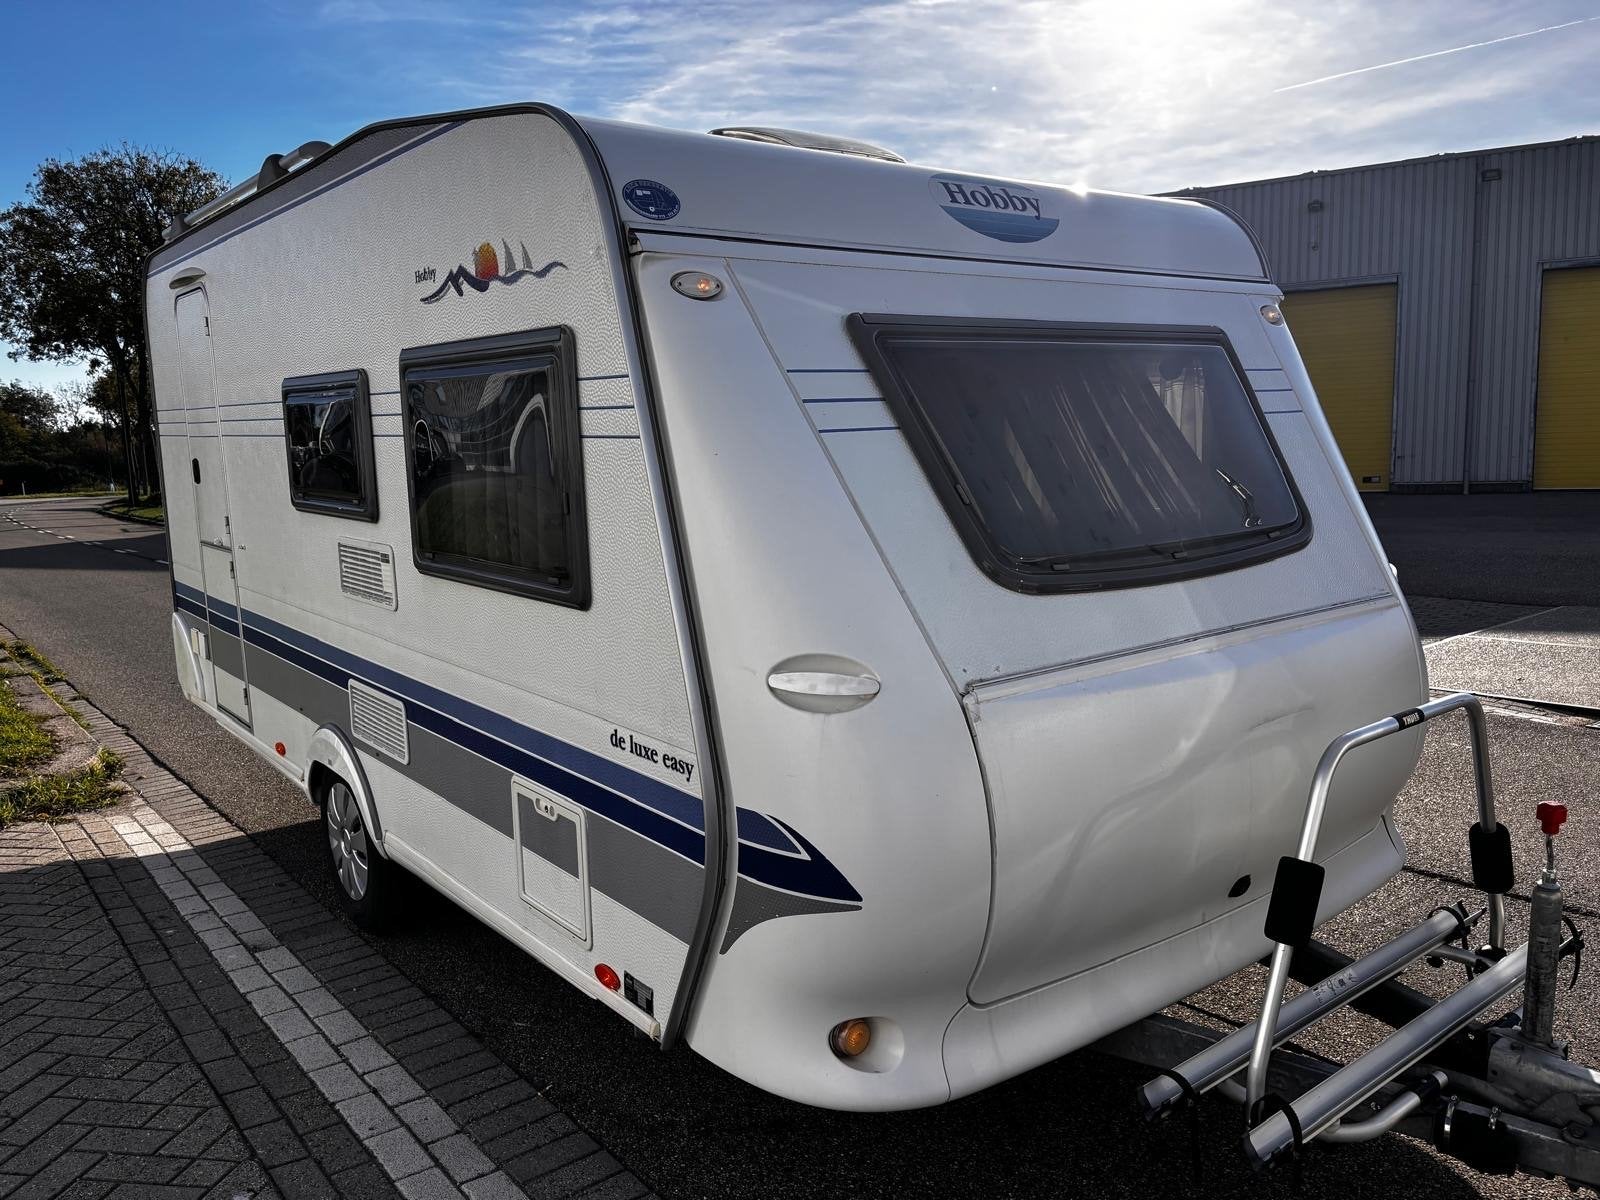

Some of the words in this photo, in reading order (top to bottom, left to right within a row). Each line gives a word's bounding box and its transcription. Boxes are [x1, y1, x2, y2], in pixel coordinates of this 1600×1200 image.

[938, 181, 1041, 220] Hobby
[415, 266, 436, 283] Hobby
[610, 728, 626, 751] de
[629, 734, 658, 764] luxe
[662, 753, 694, 782] easy
